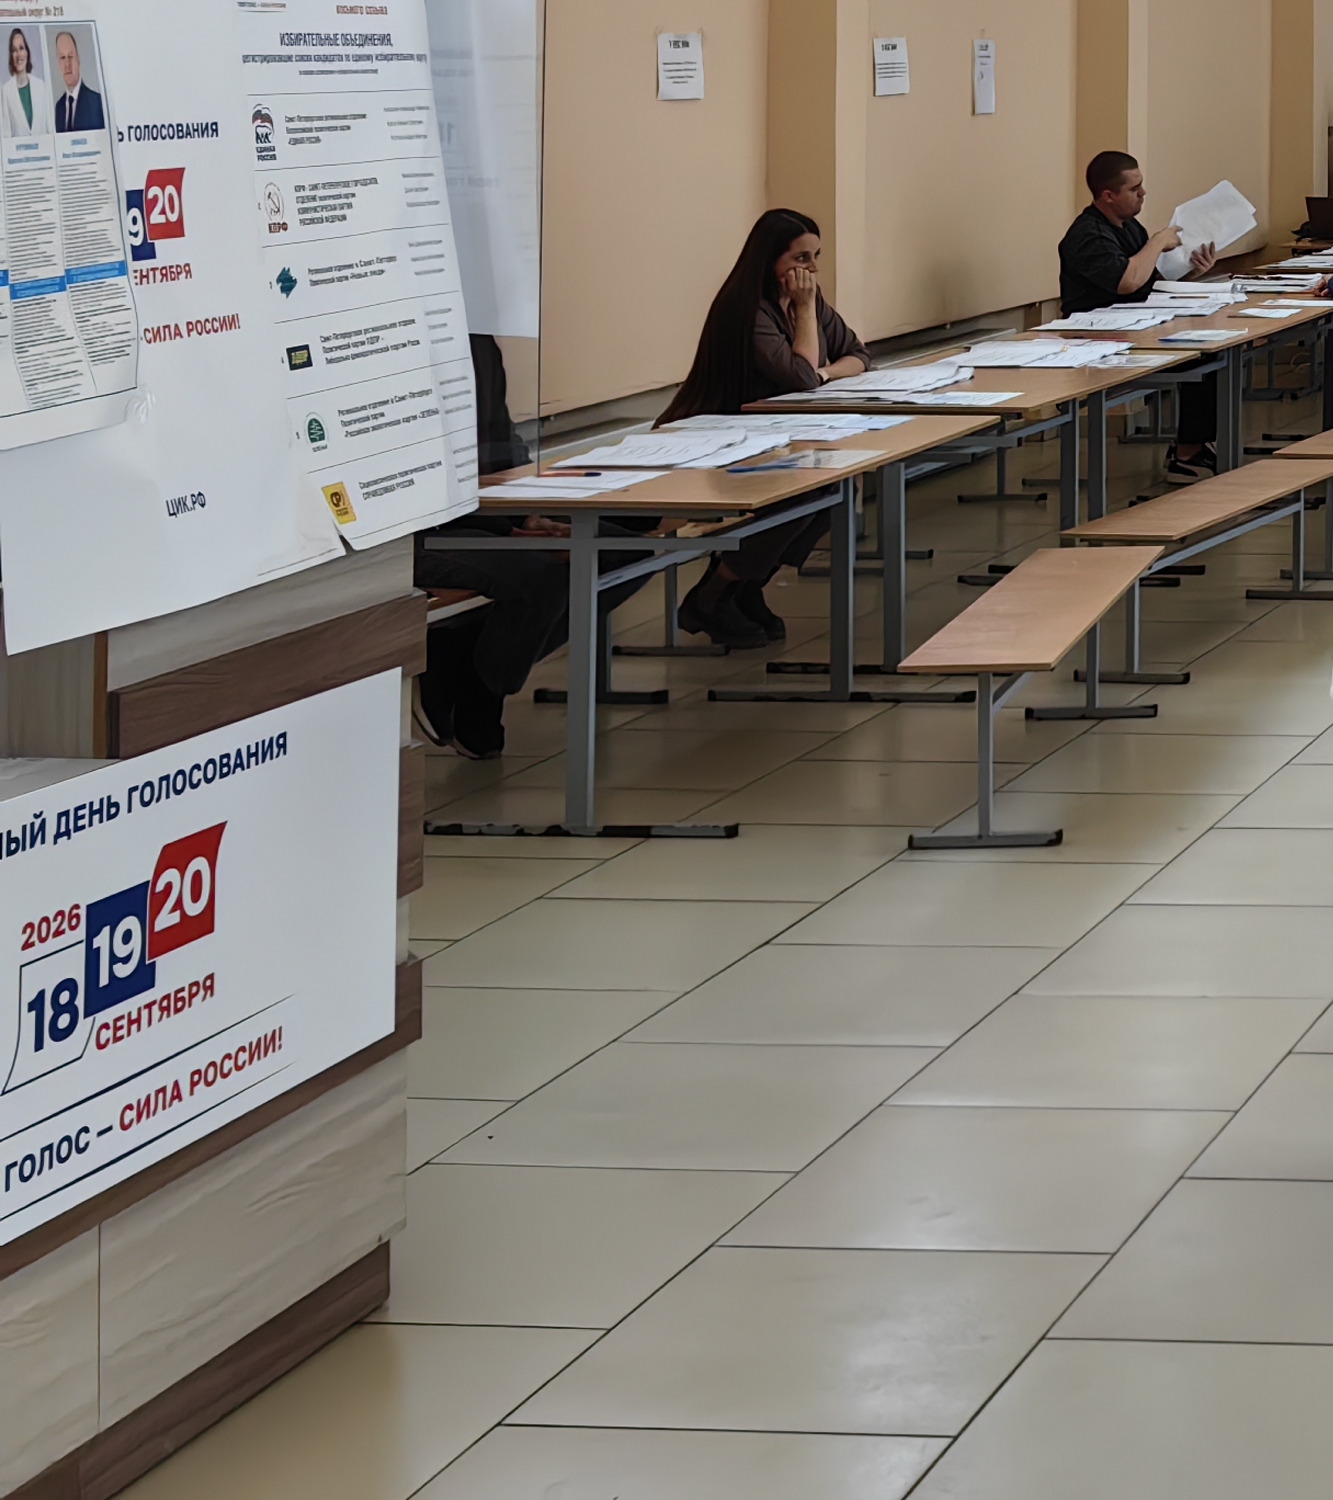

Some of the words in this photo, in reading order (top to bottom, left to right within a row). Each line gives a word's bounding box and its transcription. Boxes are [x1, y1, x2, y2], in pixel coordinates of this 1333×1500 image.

[279, 32, 340, 47] ИЗБИРАТЕЛЬНЫЕ
[127, 122, 219, 142] ГОЛОСОВАНИЯ
[127, 207, 145, 246] 9
[147, 185, 180, 224] 20
[133, 263, 192, 286] ЕНТЯБРЯ
[143, 323, 183, 345] СИЛА
[186, 313, 241, 336] РОССИИ!
[165, 490, 206, 518] ЦИК.РФ
[53, 794, 121, 846] ДЕНЬ
[126, 731, 288, 815] ГОЛОСОВАНИЯ
[154, 855, 212, 934] 20
[21, 903, 82, 952] 2026
[92, 914, 143, 988] 19
[27, 977, 80, 1053] 18
[95, 972, 215, 1051] СЕНТЯБРЯ
[4, 1125, 91, 1193] ГОЛОС
[119, 1079, 183, 1132] СИЛА
[189, 1025, 283, 1097] РОССИИ!
